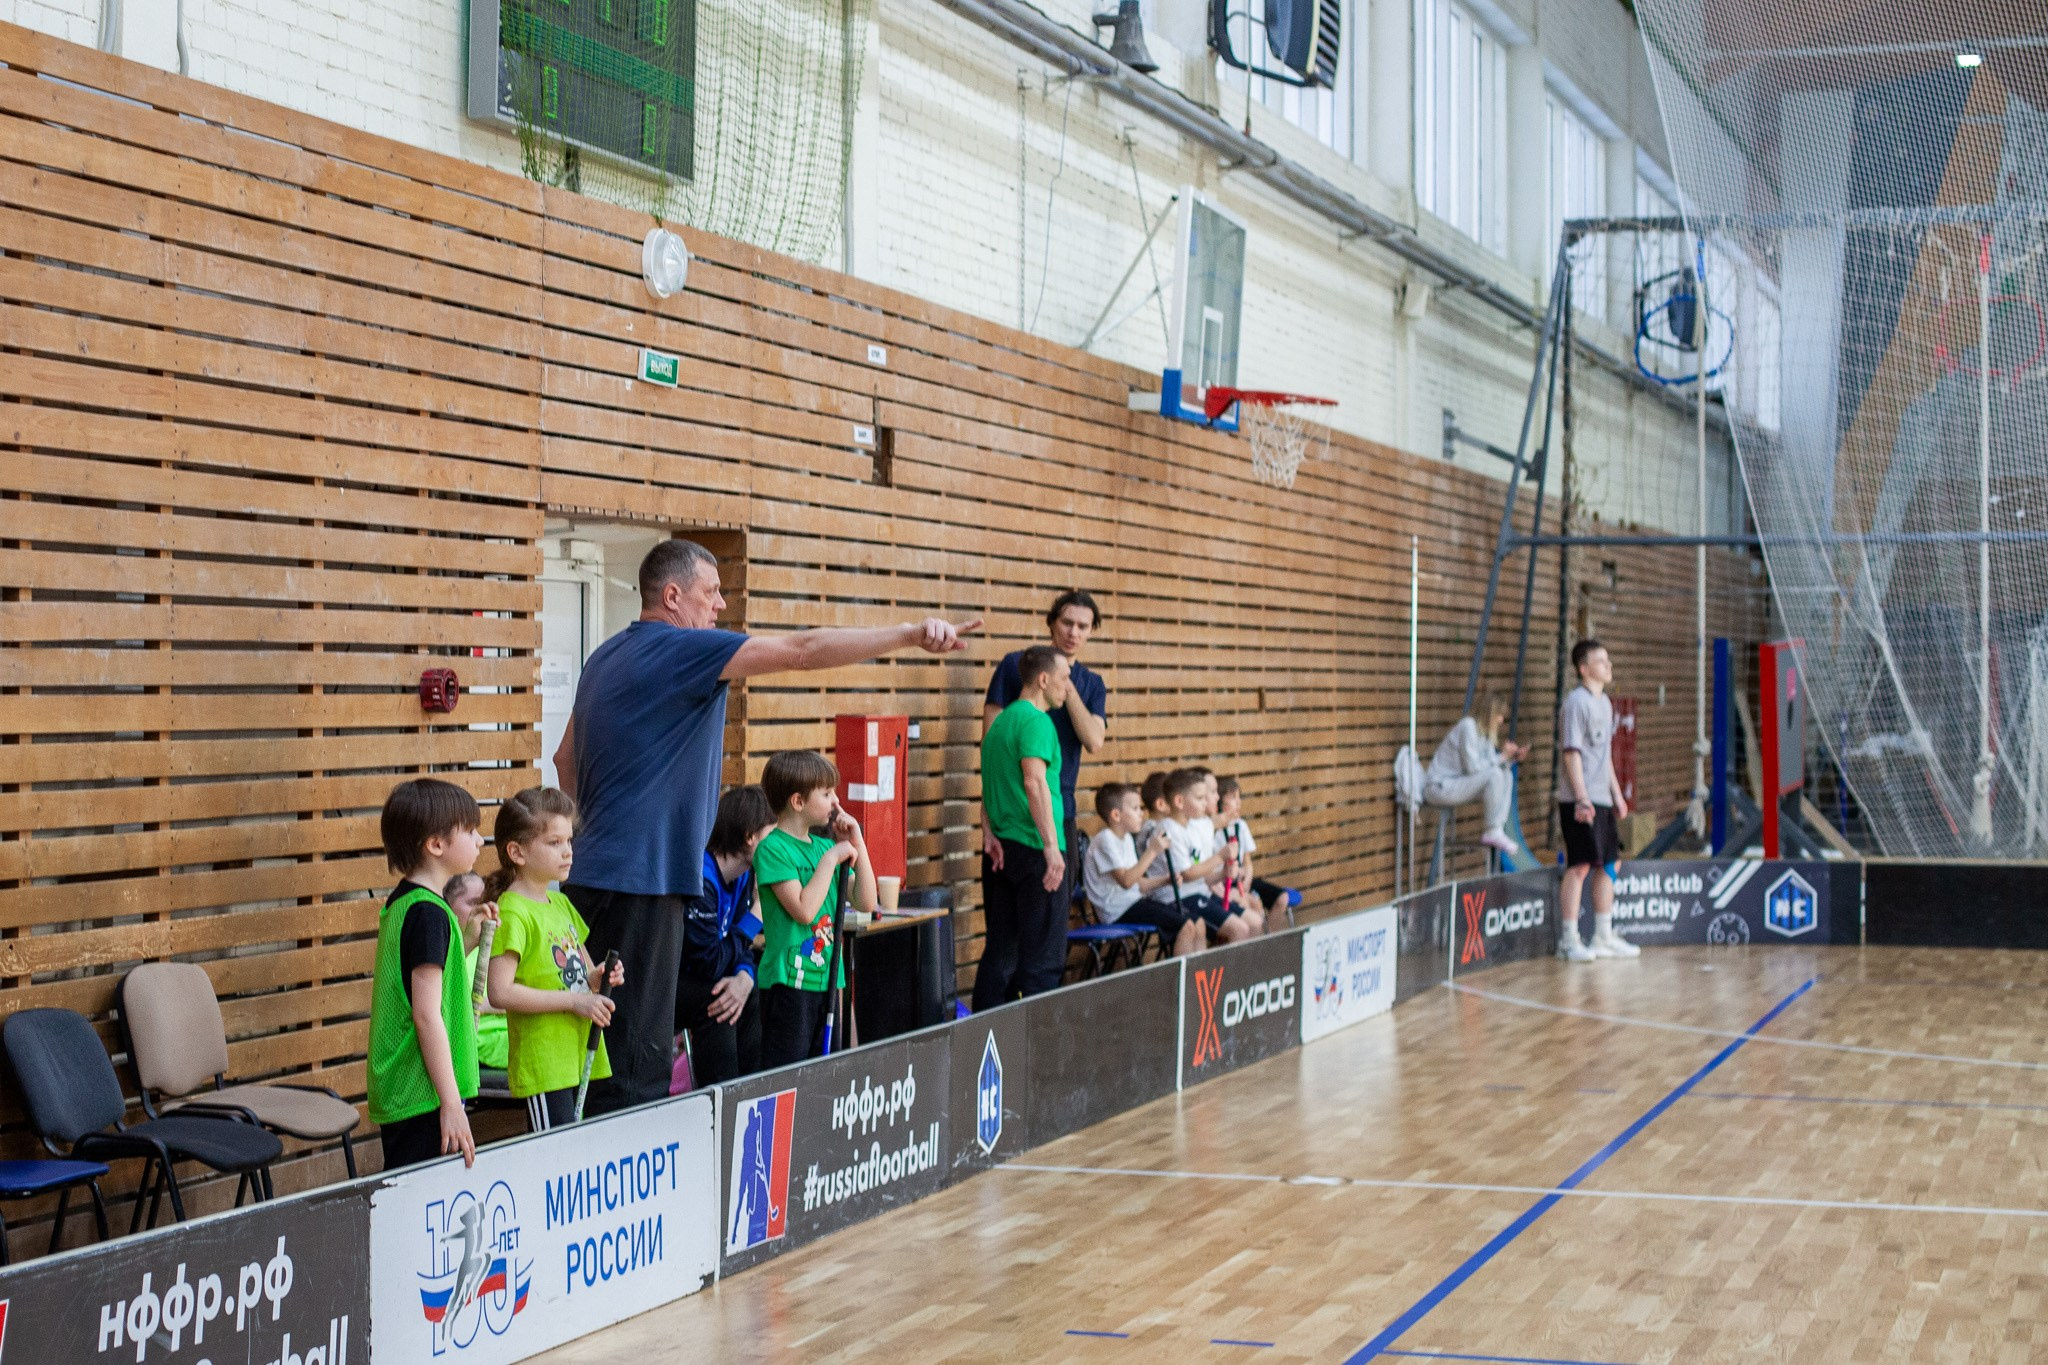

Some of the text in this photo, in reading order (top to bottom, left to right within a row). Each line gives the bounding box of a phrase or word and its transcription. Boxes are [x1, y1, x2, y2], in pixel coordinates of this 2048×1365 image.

[650, 359, 673, 378] ВЫХОД
[1647, 897, 1681, 922] City
[1664, 872, 1703, 894] club
[1485, 898, 1544, 937] OXDOG
[1222, 974, 1296, 1028] OXDOG
[831, 1063, 917, 1141] нффр.рф
[545, 1141, 680, 1231] МИНСПОРТ
[802, 1120, 940, 1213] #russiafloorball
[498, 1226, 521, 1254] ЛЕТ
[566, 1213, 663, 1295] РОССИИ
[97, 1235, 294, 1363] нффр.рф
